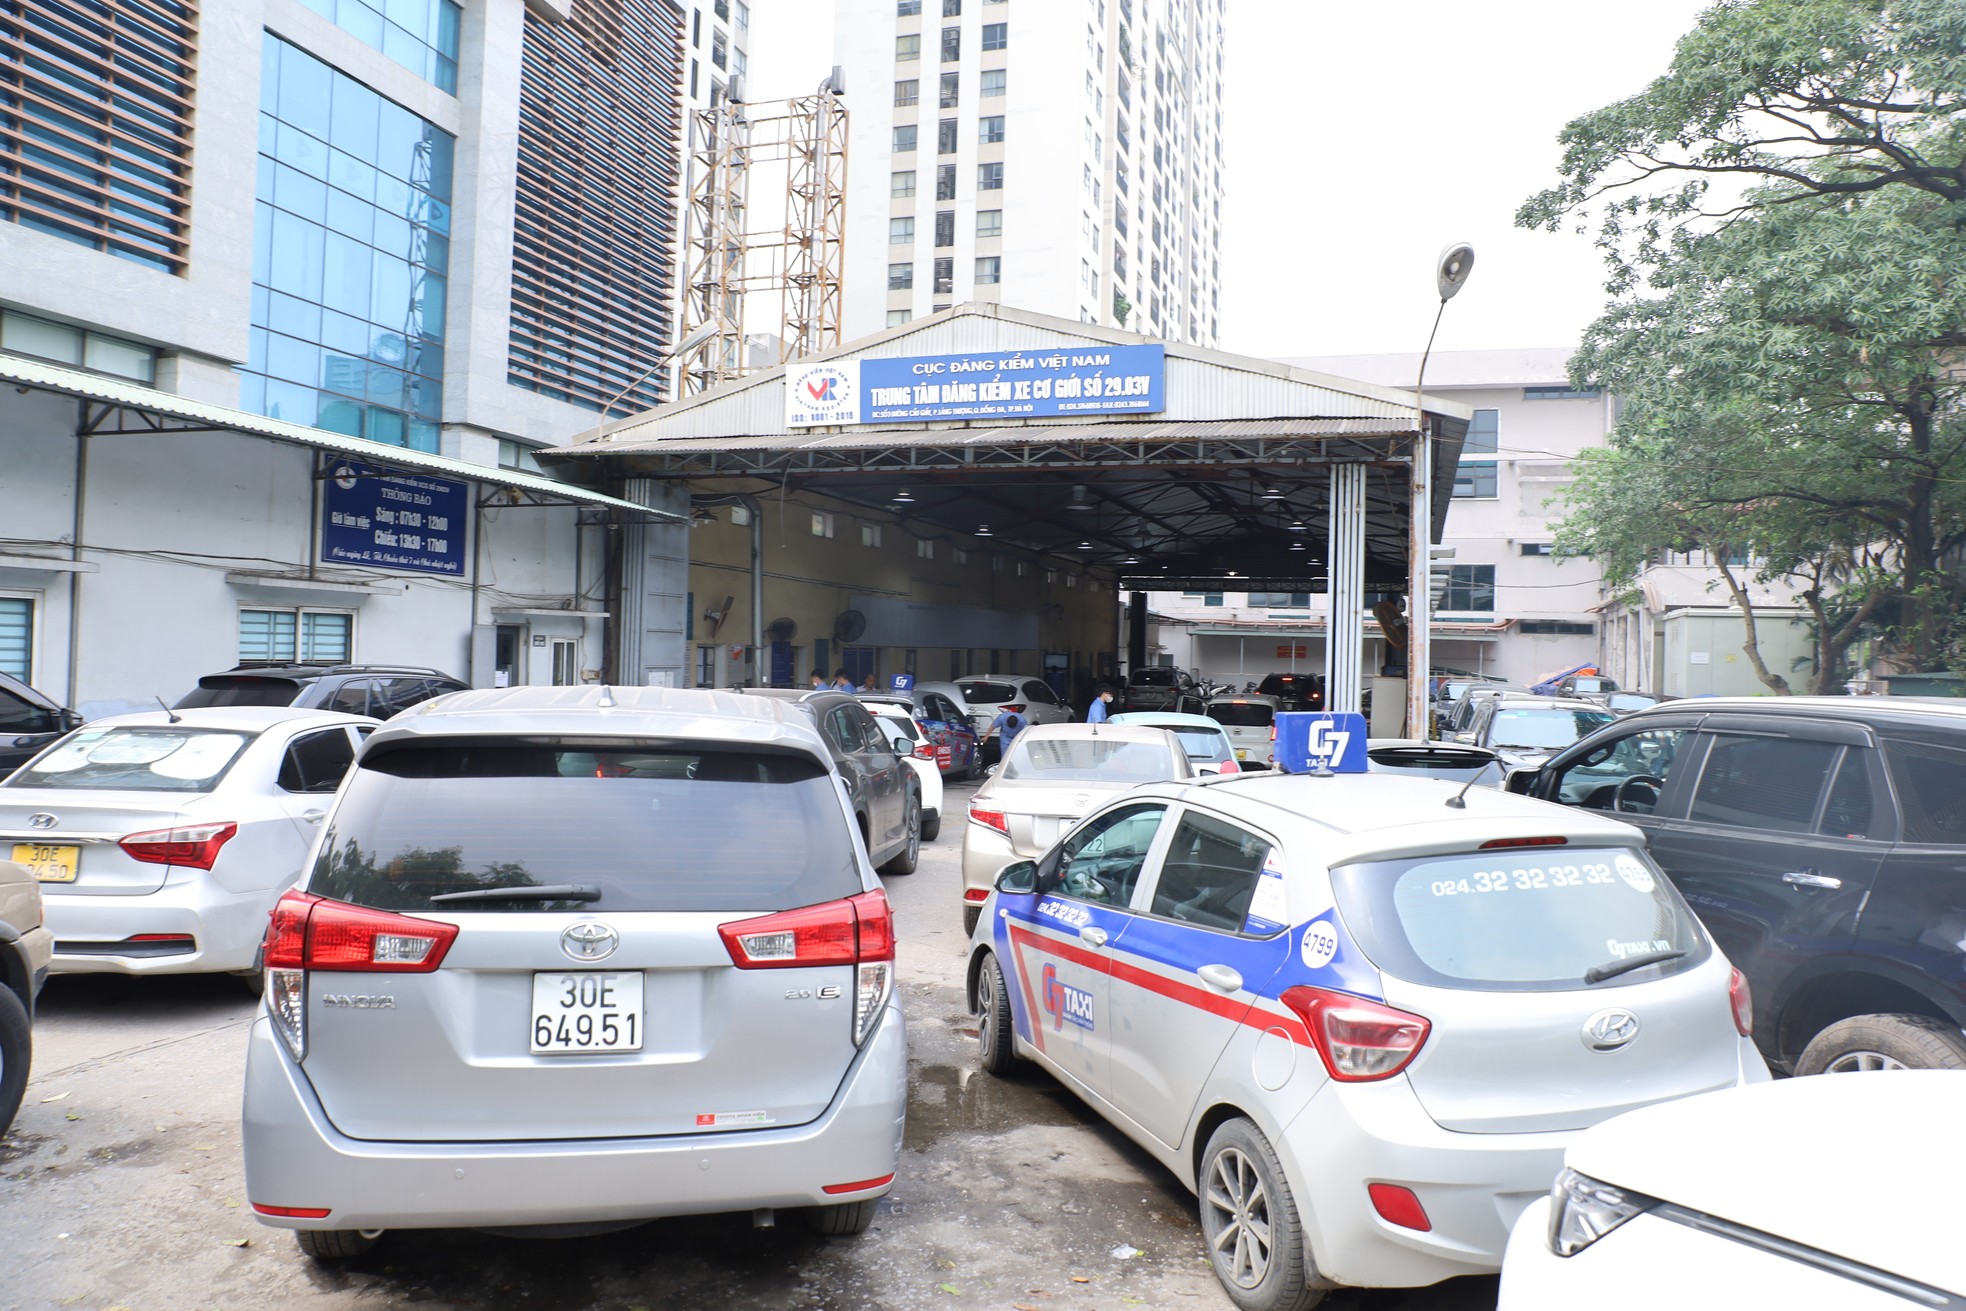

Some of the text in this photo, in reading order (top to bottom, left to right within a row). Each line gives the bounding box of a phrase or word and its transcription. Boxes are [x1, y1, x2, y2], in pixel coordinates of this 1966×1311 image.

[912, 353, 1110, 377] CỤC ĐĂNG KIỂM VIỆT NAM
[871, 370, 1150, 407] TRUNG TÂM ĐĂNG KIỂM XE CƠ GIỚI SỐ 29.03V
[381, 487, 432, 506] THÔNG BÁO
[375, 506, 395, 525] Sáng
[400, 510, 422, 527] 07h30
[399, 533, 421, 550] 13h30
[895, 676, 908, 688] G7
[1308, 720, 1350, 767] G7
[30, 847, 60, 862] 30E
[1512, 868, 1549, 890] 32
[1549, 865, 1584, 887] 32
[1582, 863, 1616, 884] 32
[1303, 932, 1334, 956] 4799
[323, 994, 397, 1009] INNOVA
[560, 975, 618, 1009] 30E
[1063, 986, 1093, 1021] TAXI
[534, 1012, 636, 1048] 649.51
